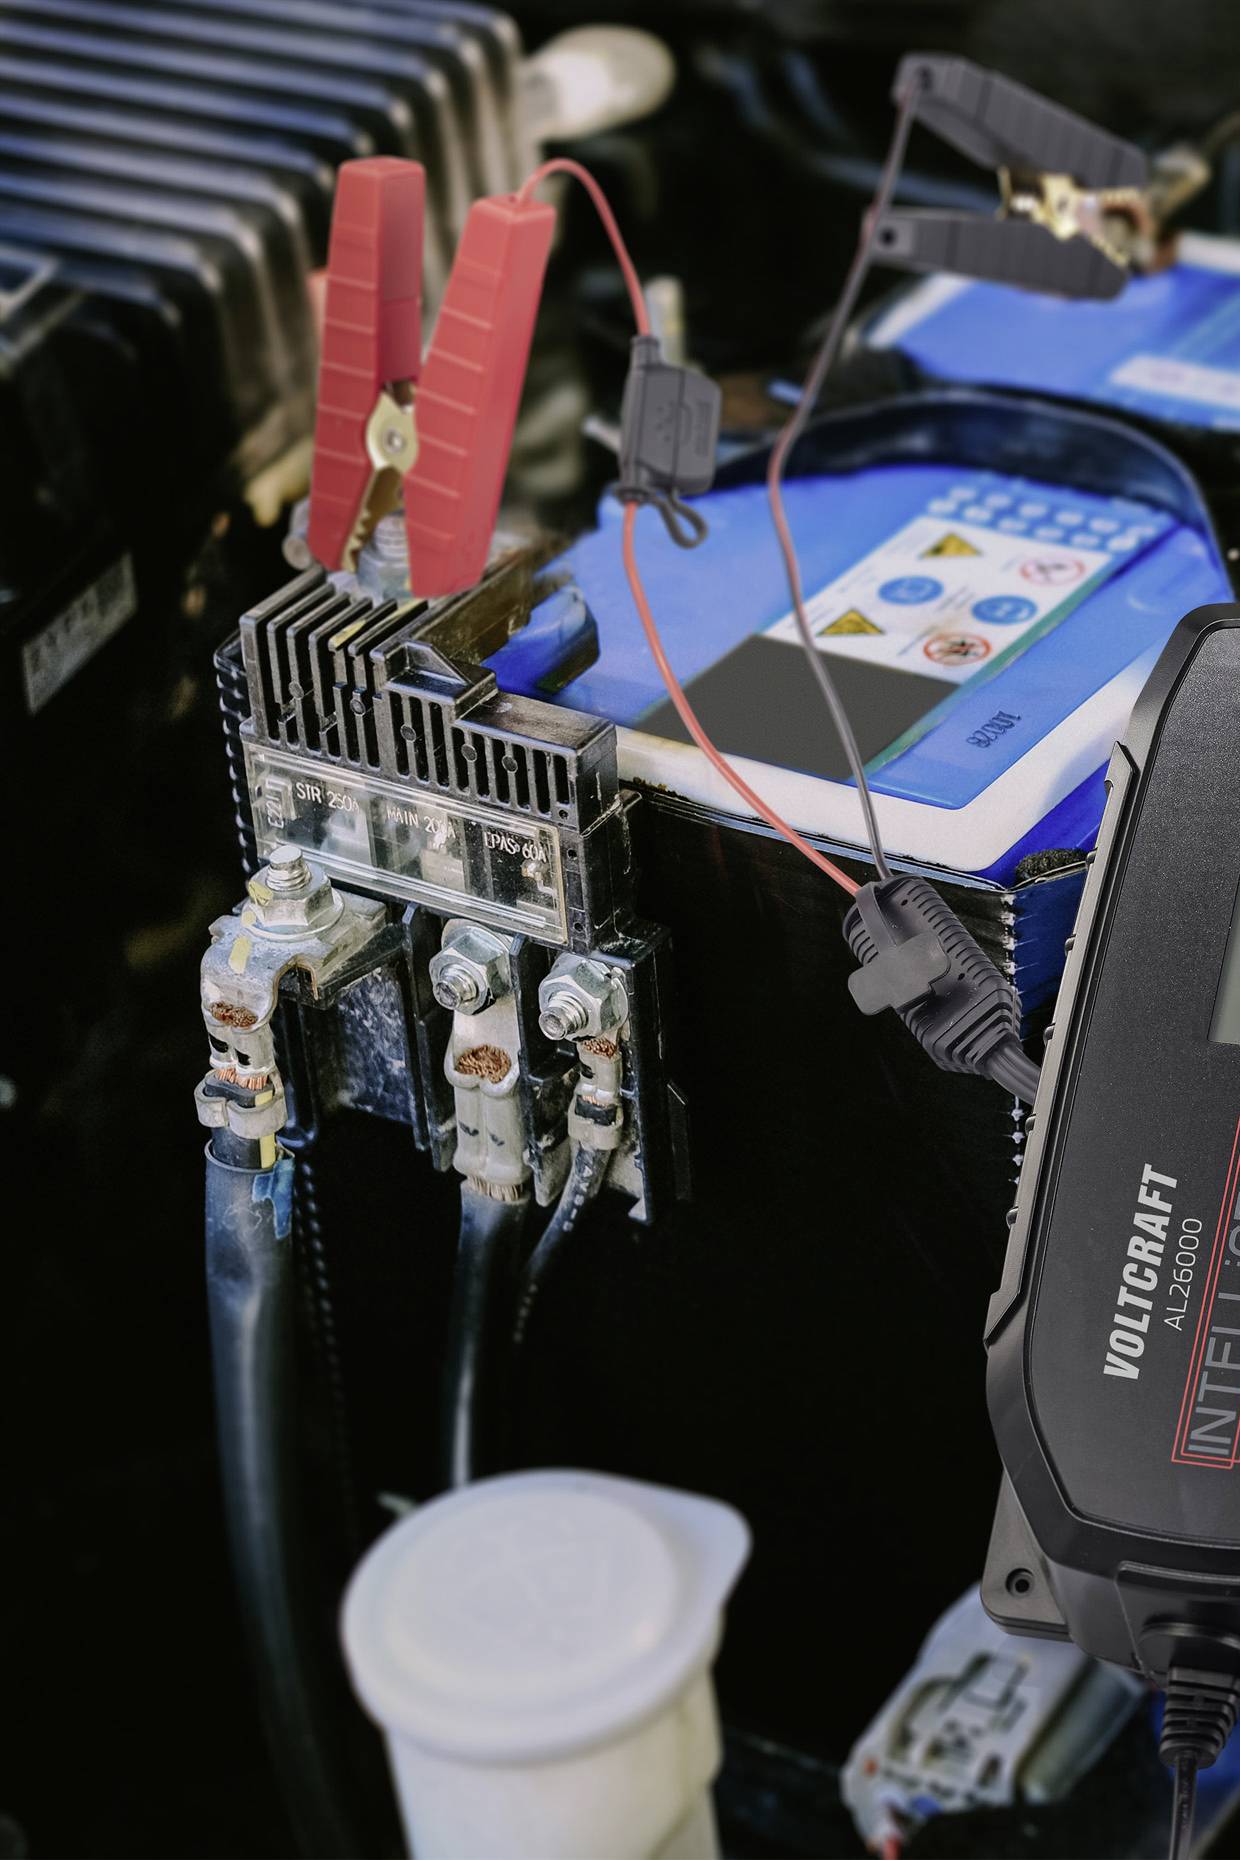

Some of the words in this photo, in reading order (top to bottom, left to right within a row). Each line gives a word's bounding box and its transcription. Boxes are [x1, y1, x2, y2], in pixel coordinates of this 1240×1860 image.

[295, 782, 322, 803] STR
[386, 806, 419, 828] MAIN
[1103, 1163, 1178, 1380] VOLTCRAFT
[1163, 1218, 1203, 1331] AL26000
